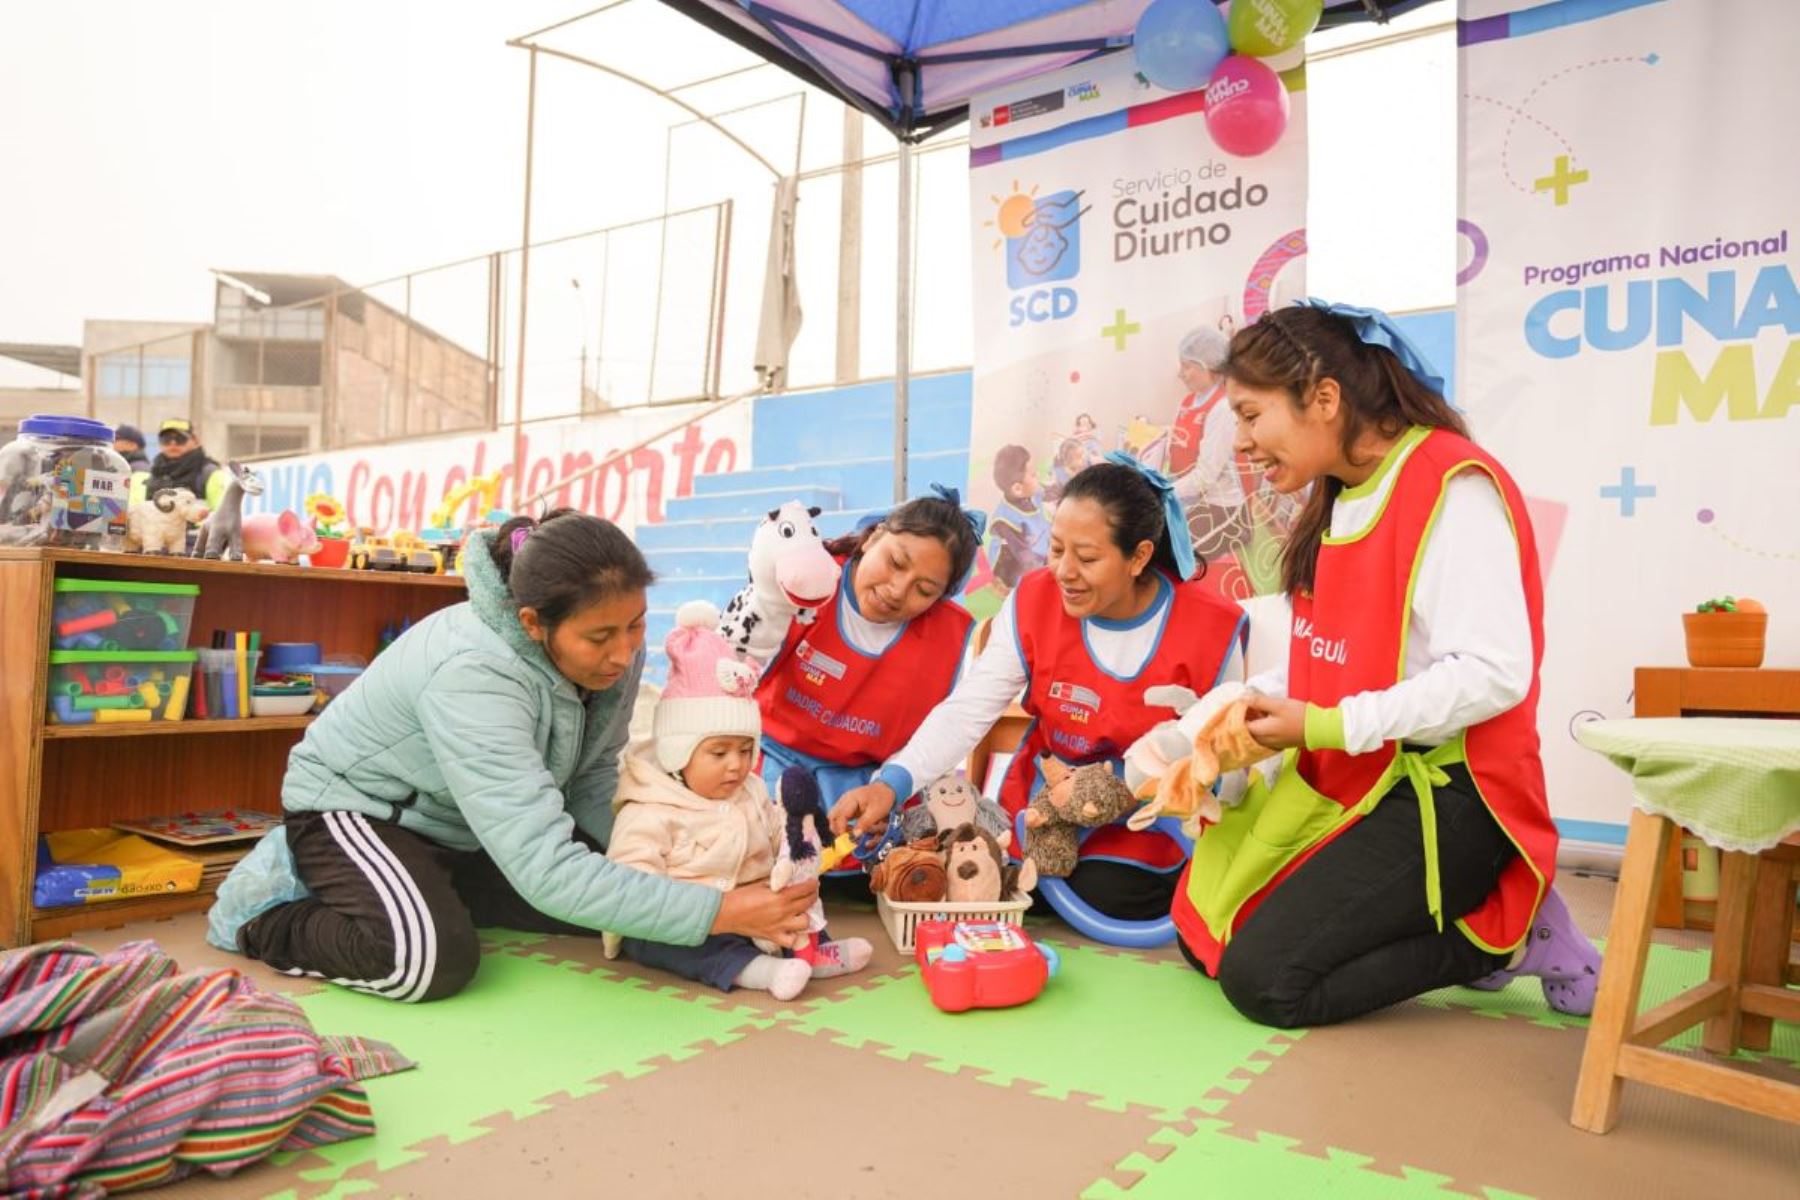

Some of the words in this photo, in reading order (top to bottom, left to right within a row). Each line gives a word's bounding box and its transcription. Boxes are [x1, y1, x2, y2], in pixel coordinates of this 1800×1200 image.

[1112, 168, 1192, 199] Servicio
[1198, 158, 1227, 180] de
[1113, 176, 1269, 229] Cuidado
[1114, 222, 1231, 263] Diurno
[1524, 252, 1650, 286] Programa
[1659, 229, 1788, 268] Nacional
[1009, 287, 1078, 327] SCD
[1524, 264, 1800, 360] CUNA
[1648, 339, 1800, 427] MA
